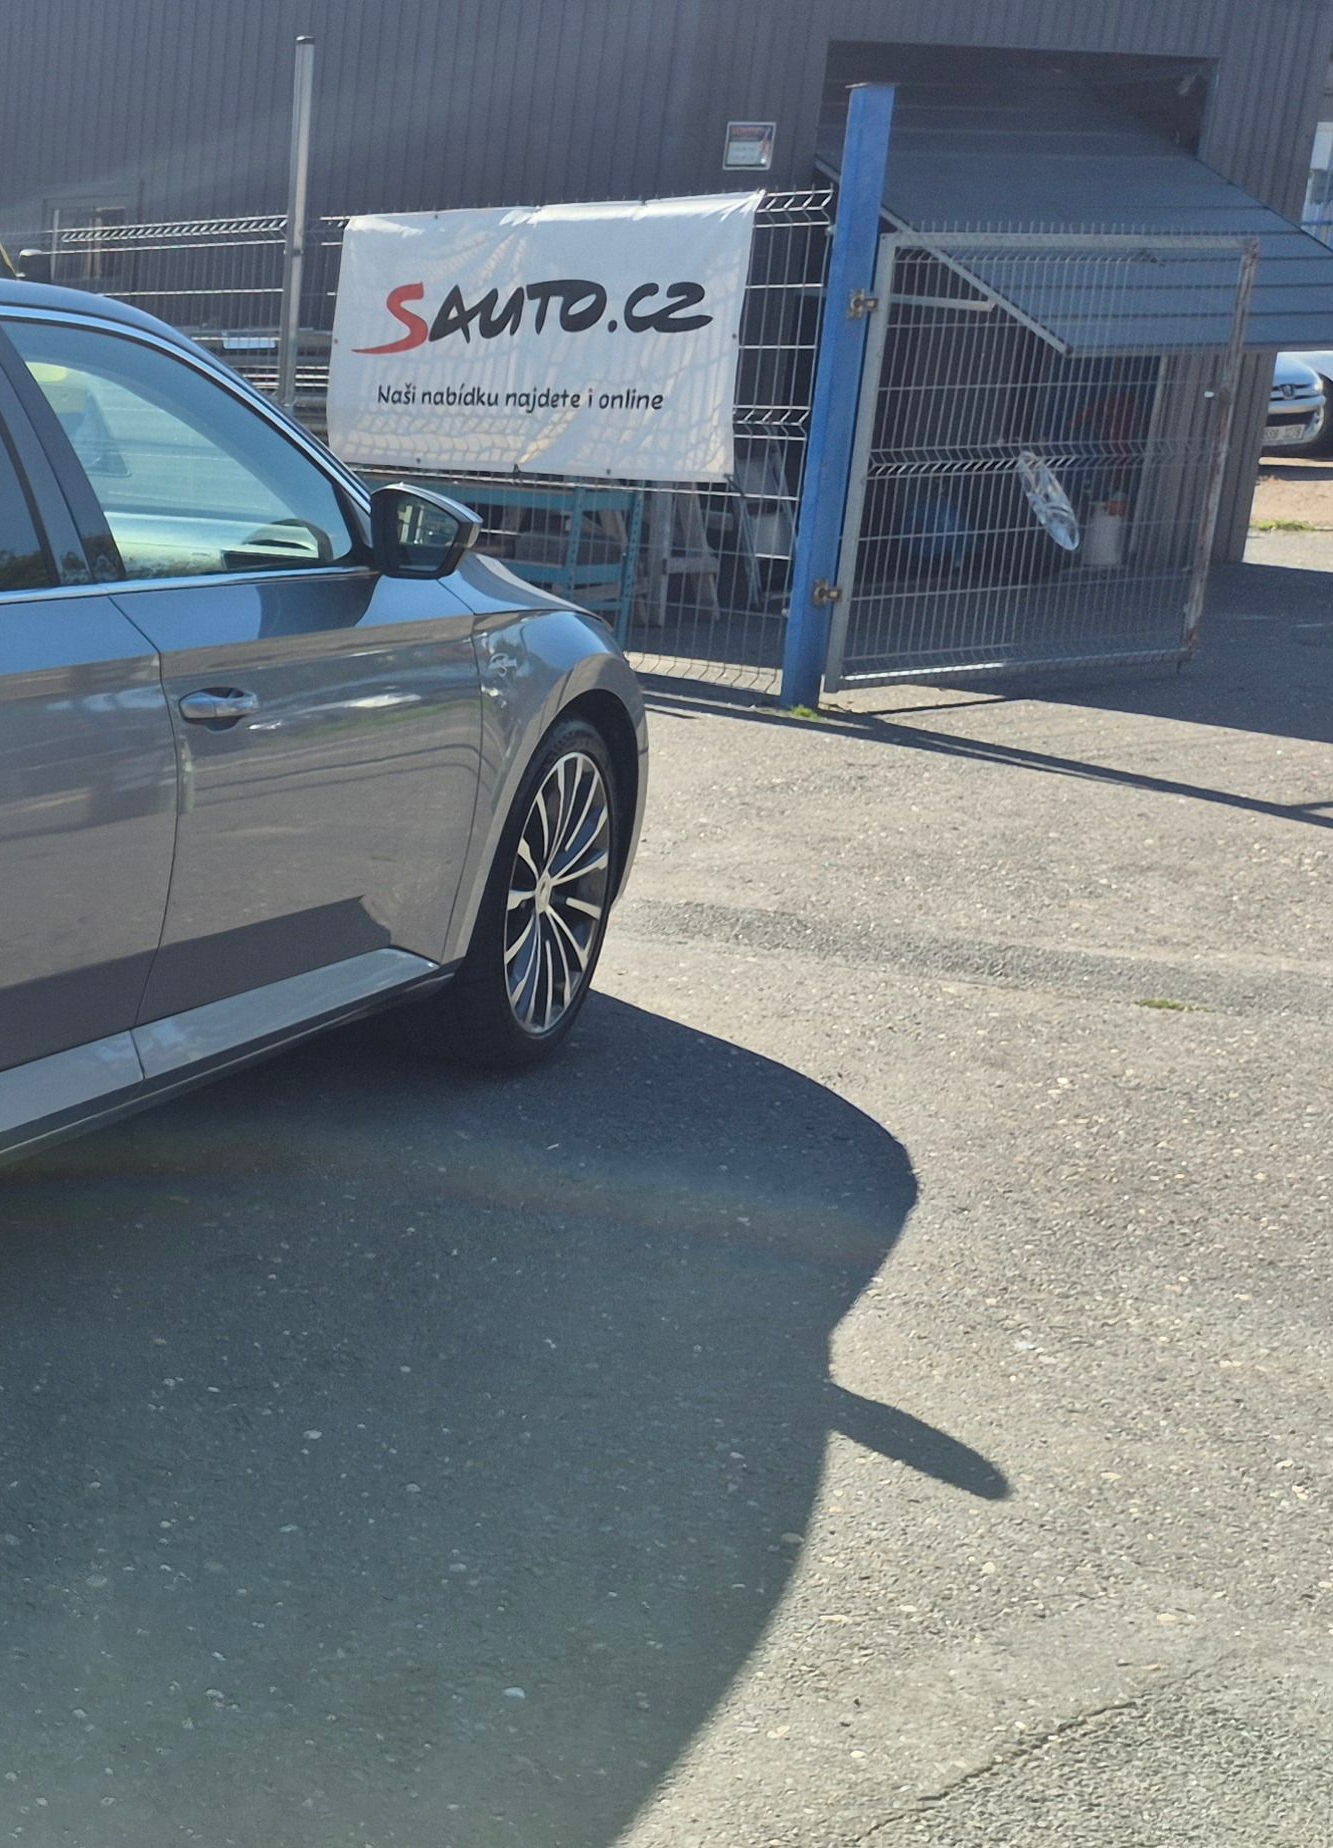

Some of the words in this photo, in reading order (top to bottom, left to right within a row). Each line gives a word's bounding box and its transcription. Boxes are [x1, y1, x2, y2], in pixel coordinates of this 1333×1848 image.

[377, 383, 417, 405] Naši
[421, 381, 499, 406] nabídku
[506, 387, 581, 413] najdete
[588, 388, 594, 409] i
[598, 388, 664, 410] online
